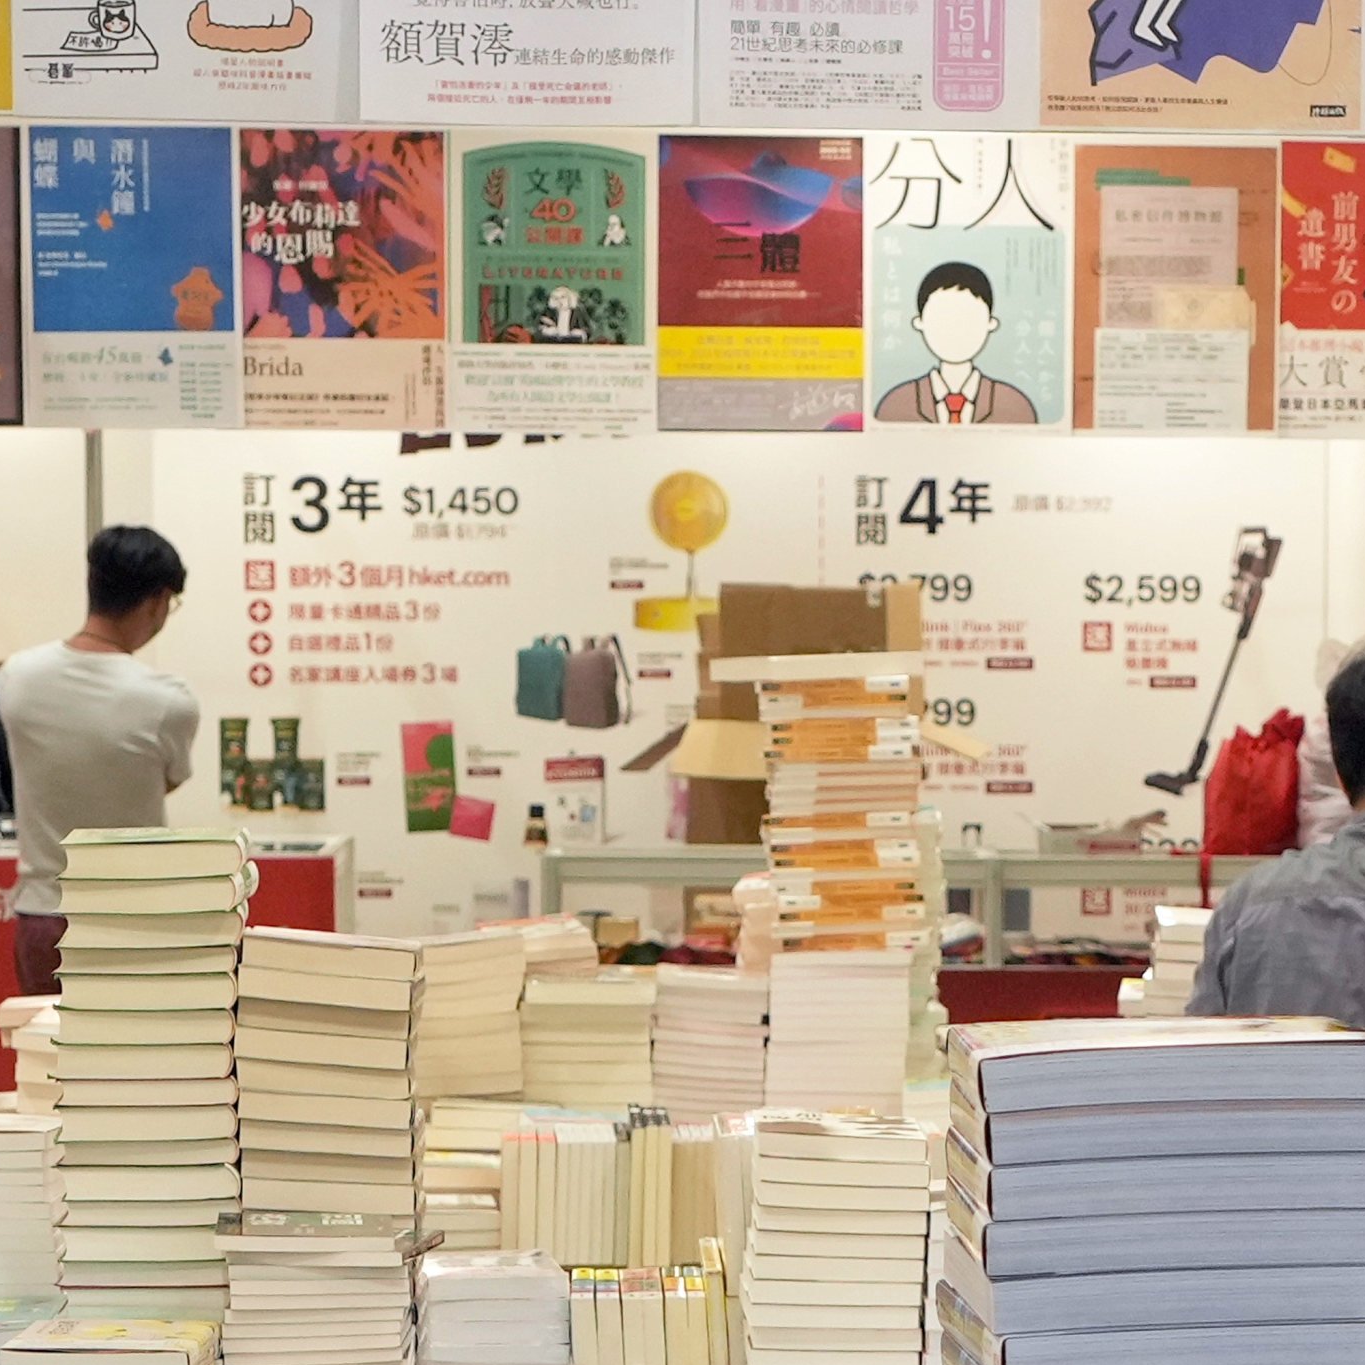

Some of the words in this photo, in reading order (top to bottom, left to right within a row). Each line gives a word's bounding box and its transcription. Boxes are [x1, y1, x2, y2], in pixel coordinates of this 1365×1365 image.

[945, 7, 976, 32] 15
[380, 19, 515, 67] 額賀澪
[524, 168, 583, 196] 文學
[530, 197, 577, 223] 40
[250, 230, 335, 264] 的恩賜
[713, 220, 801, 273] 三體
[1297, 208, 1327, 271] 遺書
[1331, 192, 1357, 314] 前男友の
[243, 356, 305, 377] Brida
[243, 473, 275, 544] 訂閱
[402, 486, 519, 519] $1,450
[856, 475, 889, 546] 訂閱
[1084, 574, 1202, 606] $2,599
